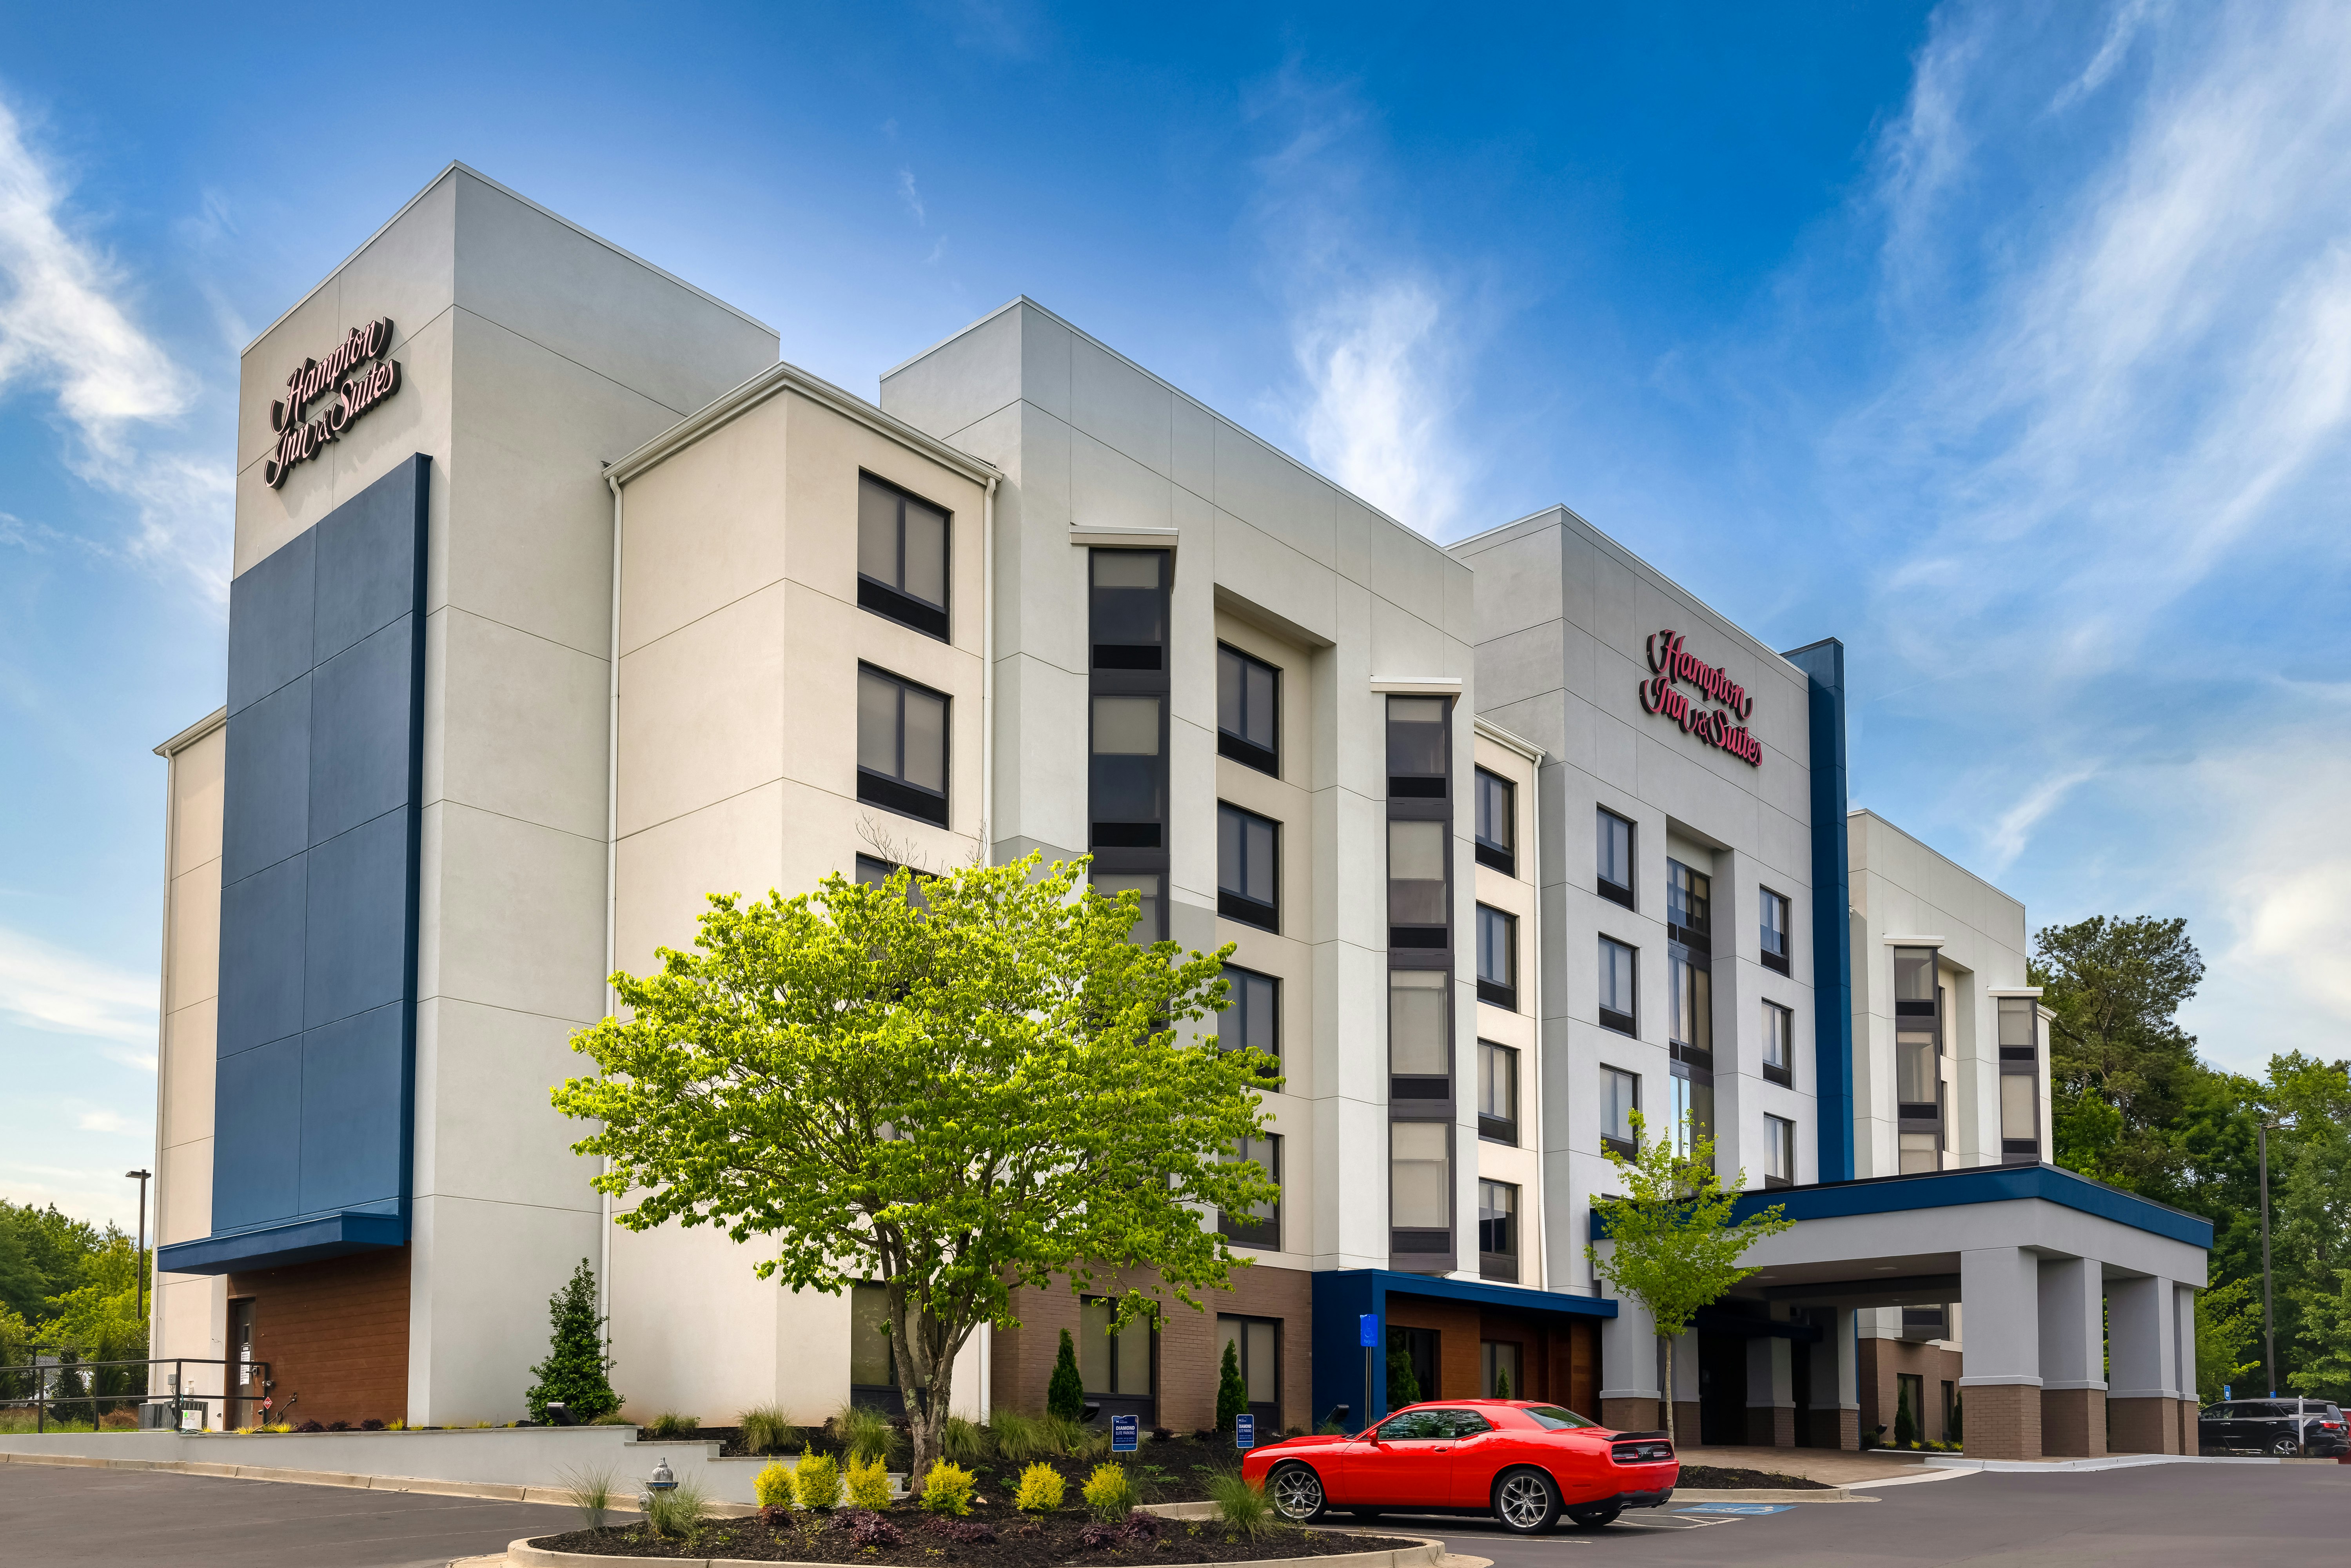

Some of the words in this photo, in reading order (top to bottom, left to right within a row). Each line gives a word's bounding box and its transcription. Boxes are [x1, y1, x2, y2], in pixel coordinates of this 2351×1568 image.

[264, 420, 324, 490] Inn
[318, 408, 337, 443] &
[330, 359, 402, 433] Suites
[271, 316, 394, 436] Hampton
[1639, 676, 1698, 733] Inn
[1696, 710, 1712, 744] &
[1709, 709, 1763, 767] Suites
[1647, 629, 1753, 720] Hampton
